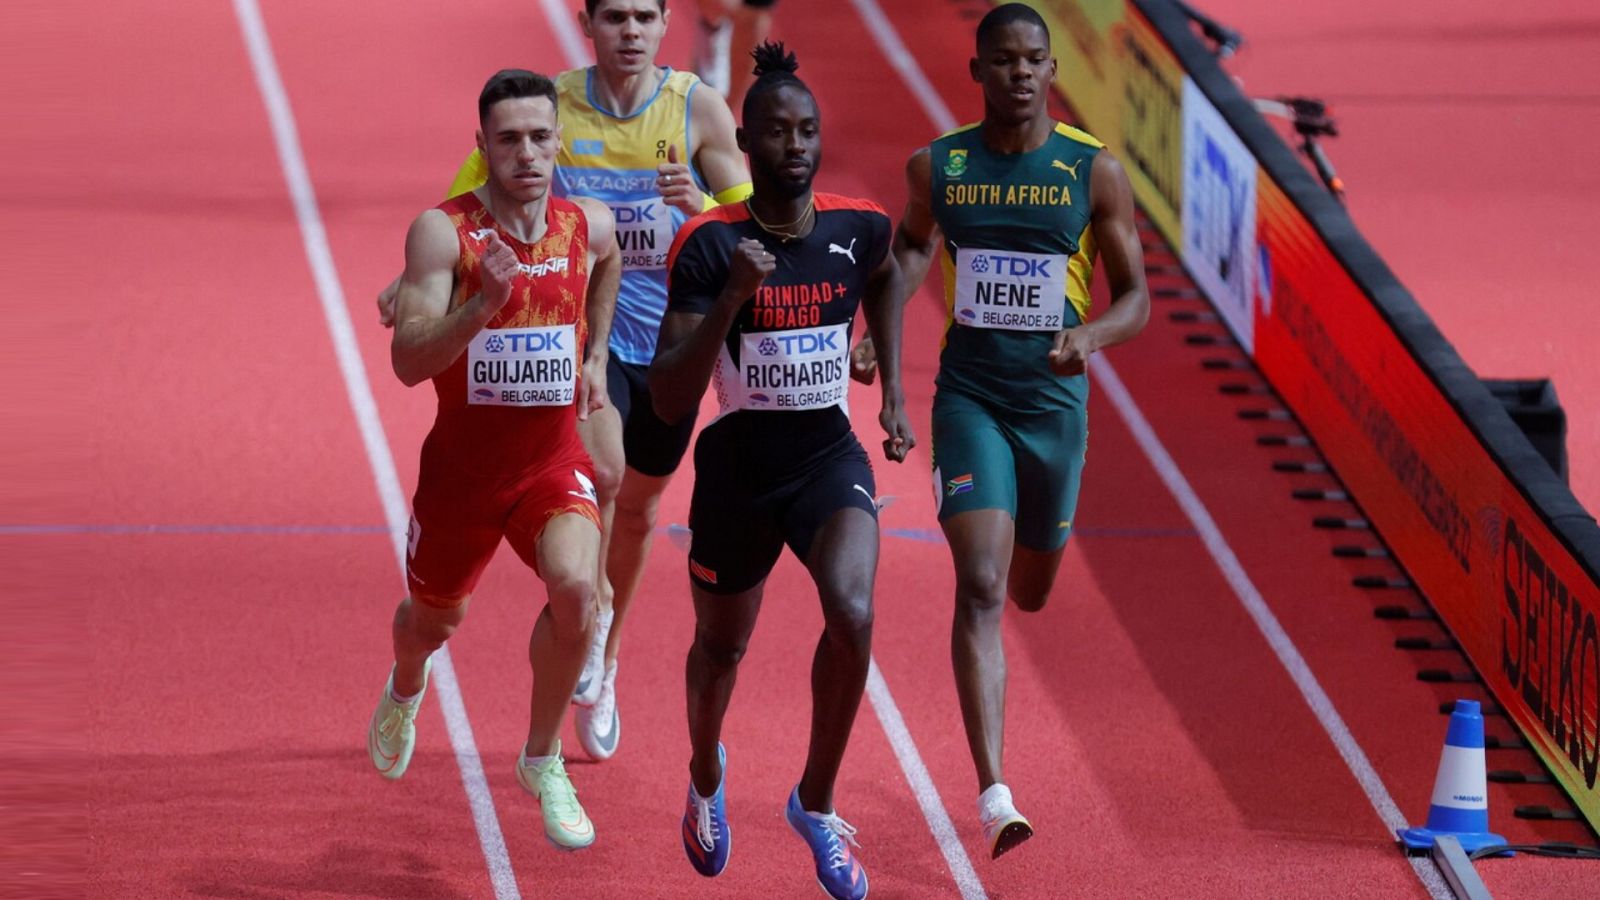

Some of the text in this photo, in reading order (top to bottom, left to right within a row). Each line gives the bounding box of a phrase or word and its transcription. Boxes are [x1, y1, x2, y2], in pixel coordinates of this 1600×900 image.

[945, 184, 1072, 207] SOUTH AFRICA
[615, 228, 656, 251] VIN
[516, 256, 569, 277] PAÑA
[622, 255, 653, 267] RADE
[990, 254, 1052, 279] TDK
[755, 281, 833, 307] TRINIDAD
[975, 281, 1041, 309] NENE
[752, 304, 821, 329] TOBAGO
[982, 311, 1060, 328] BELGRADE 22
[504, 331, 564, 353] TDK
[777, 330, 838, 355] TDK
[473, 357, 572, 384] GUIJARRO
[746, 356, 842, 389] RICHARDS
[501, 389, 561, 403] BELGRADE
[776, 389, 833, 407] BELGRADE
[1502, 516, 1600, 791] SEIKO
